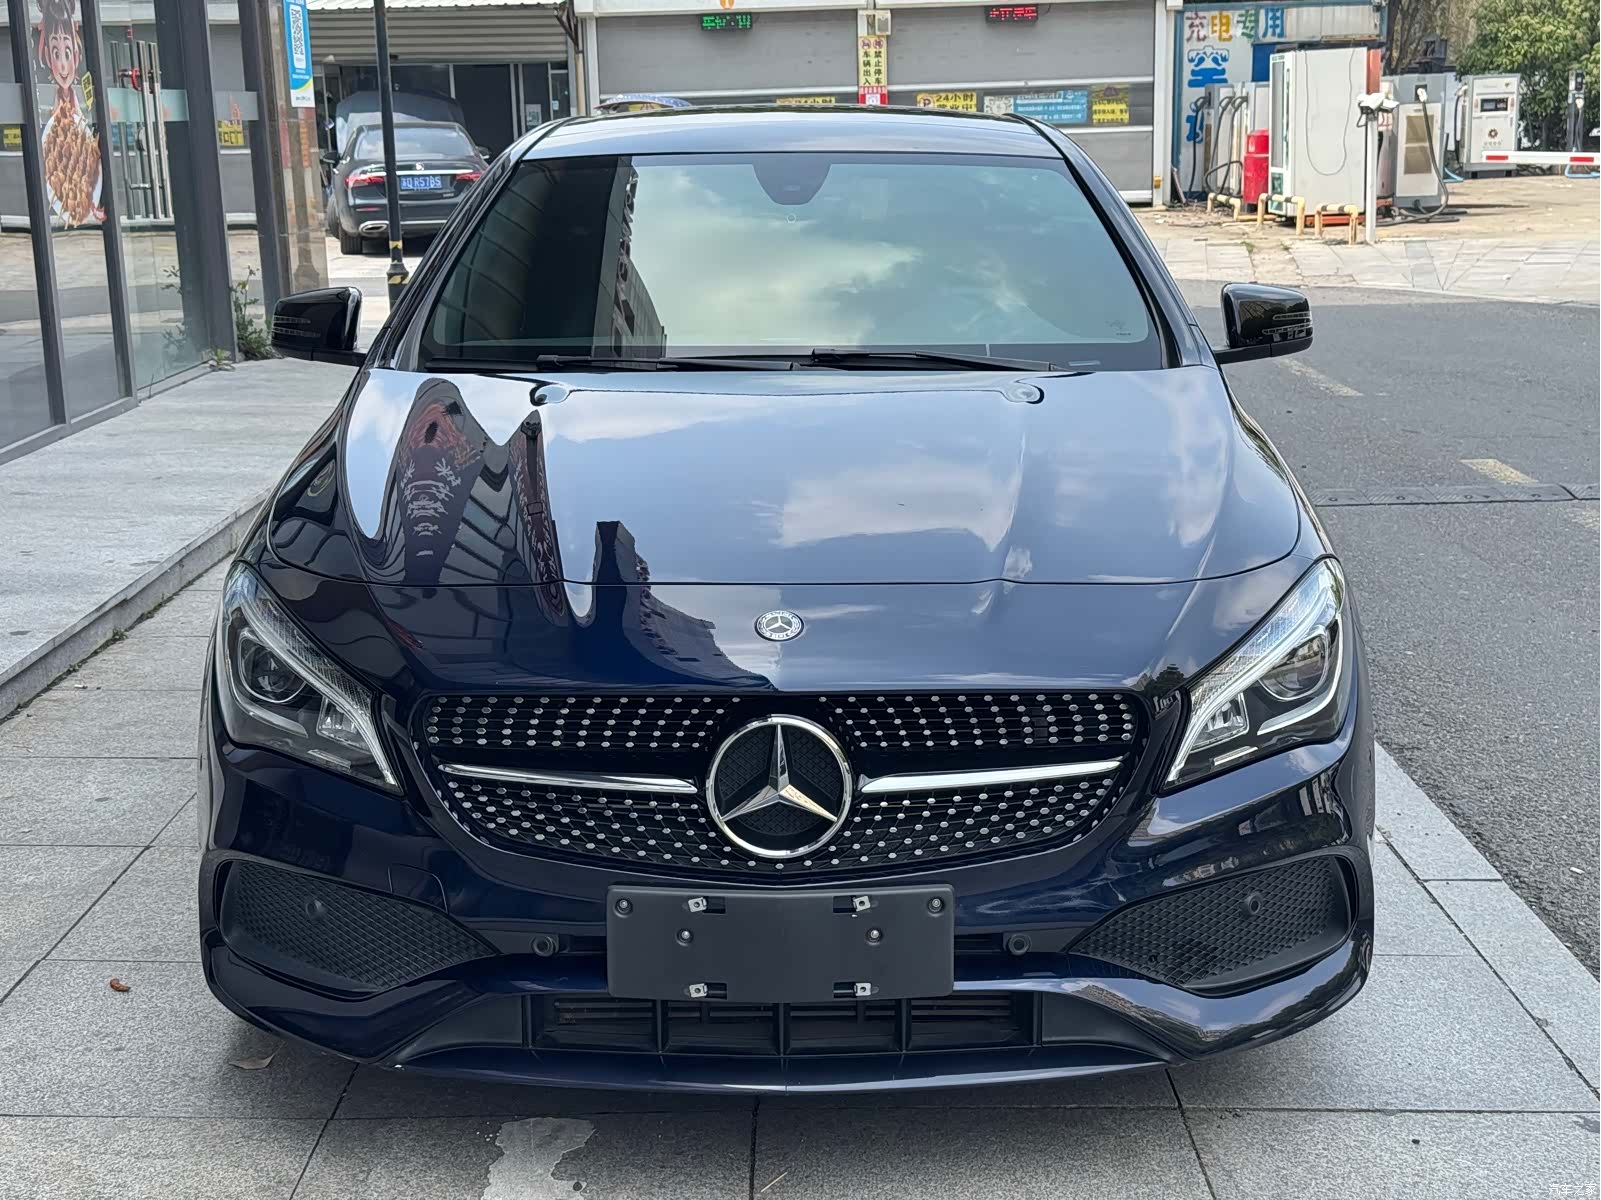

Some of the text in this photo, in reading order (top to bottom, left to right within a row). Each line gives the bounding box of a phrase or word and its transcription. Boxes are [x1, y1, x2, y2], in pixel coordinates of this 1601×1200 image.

[1185, 8, 1285, 41] 充电专用
[873, 50, 883, 84] 禁止停车
